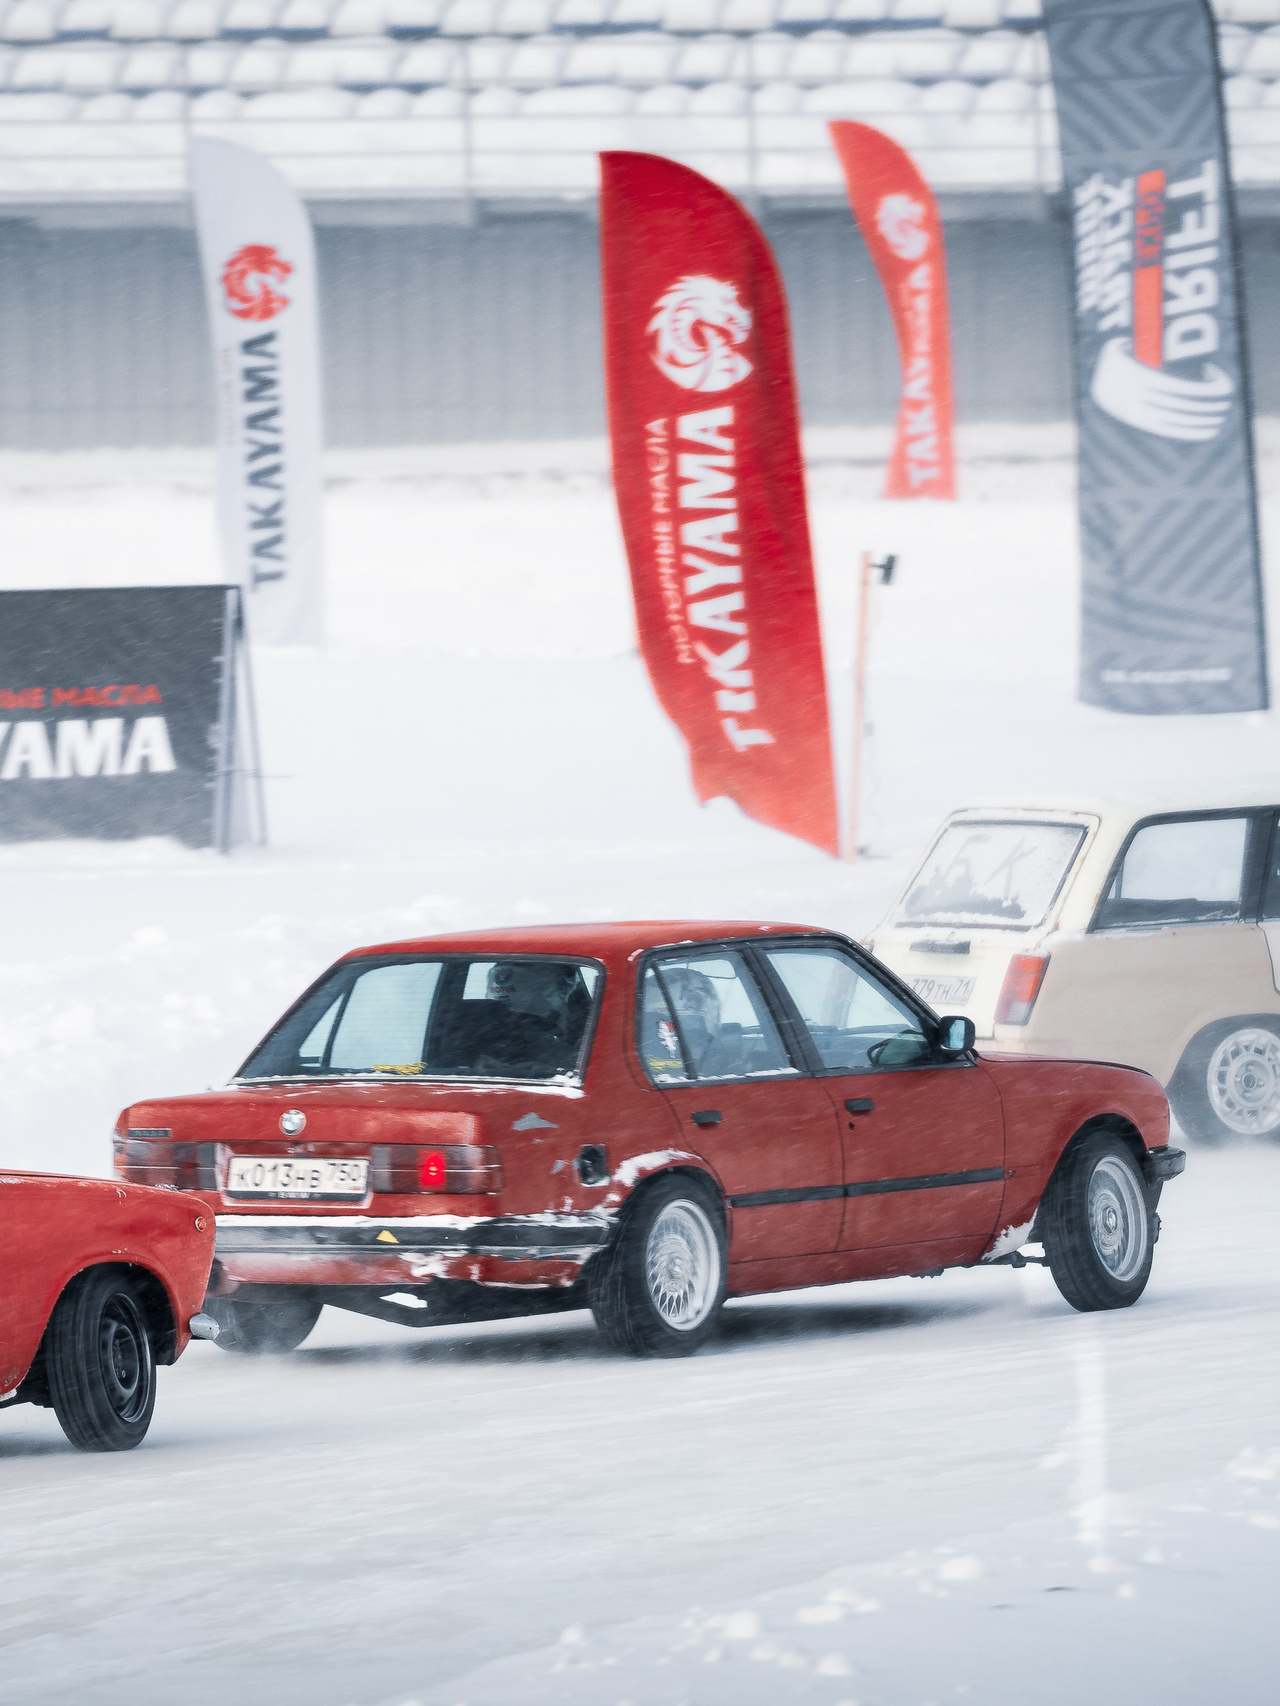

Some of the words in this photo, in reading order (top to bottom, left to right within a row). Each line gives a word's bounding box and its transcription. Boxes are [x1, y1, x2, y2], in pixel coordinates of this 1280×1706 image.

[239, 328, 287, 591] TAKAYAMA
[644, 417, 670, 514] МАСЛА
[51, 684, 162, 706] МАСЛА
[954, 979, 971, 996] 71
[328, 1162, 360, 1182] 750
